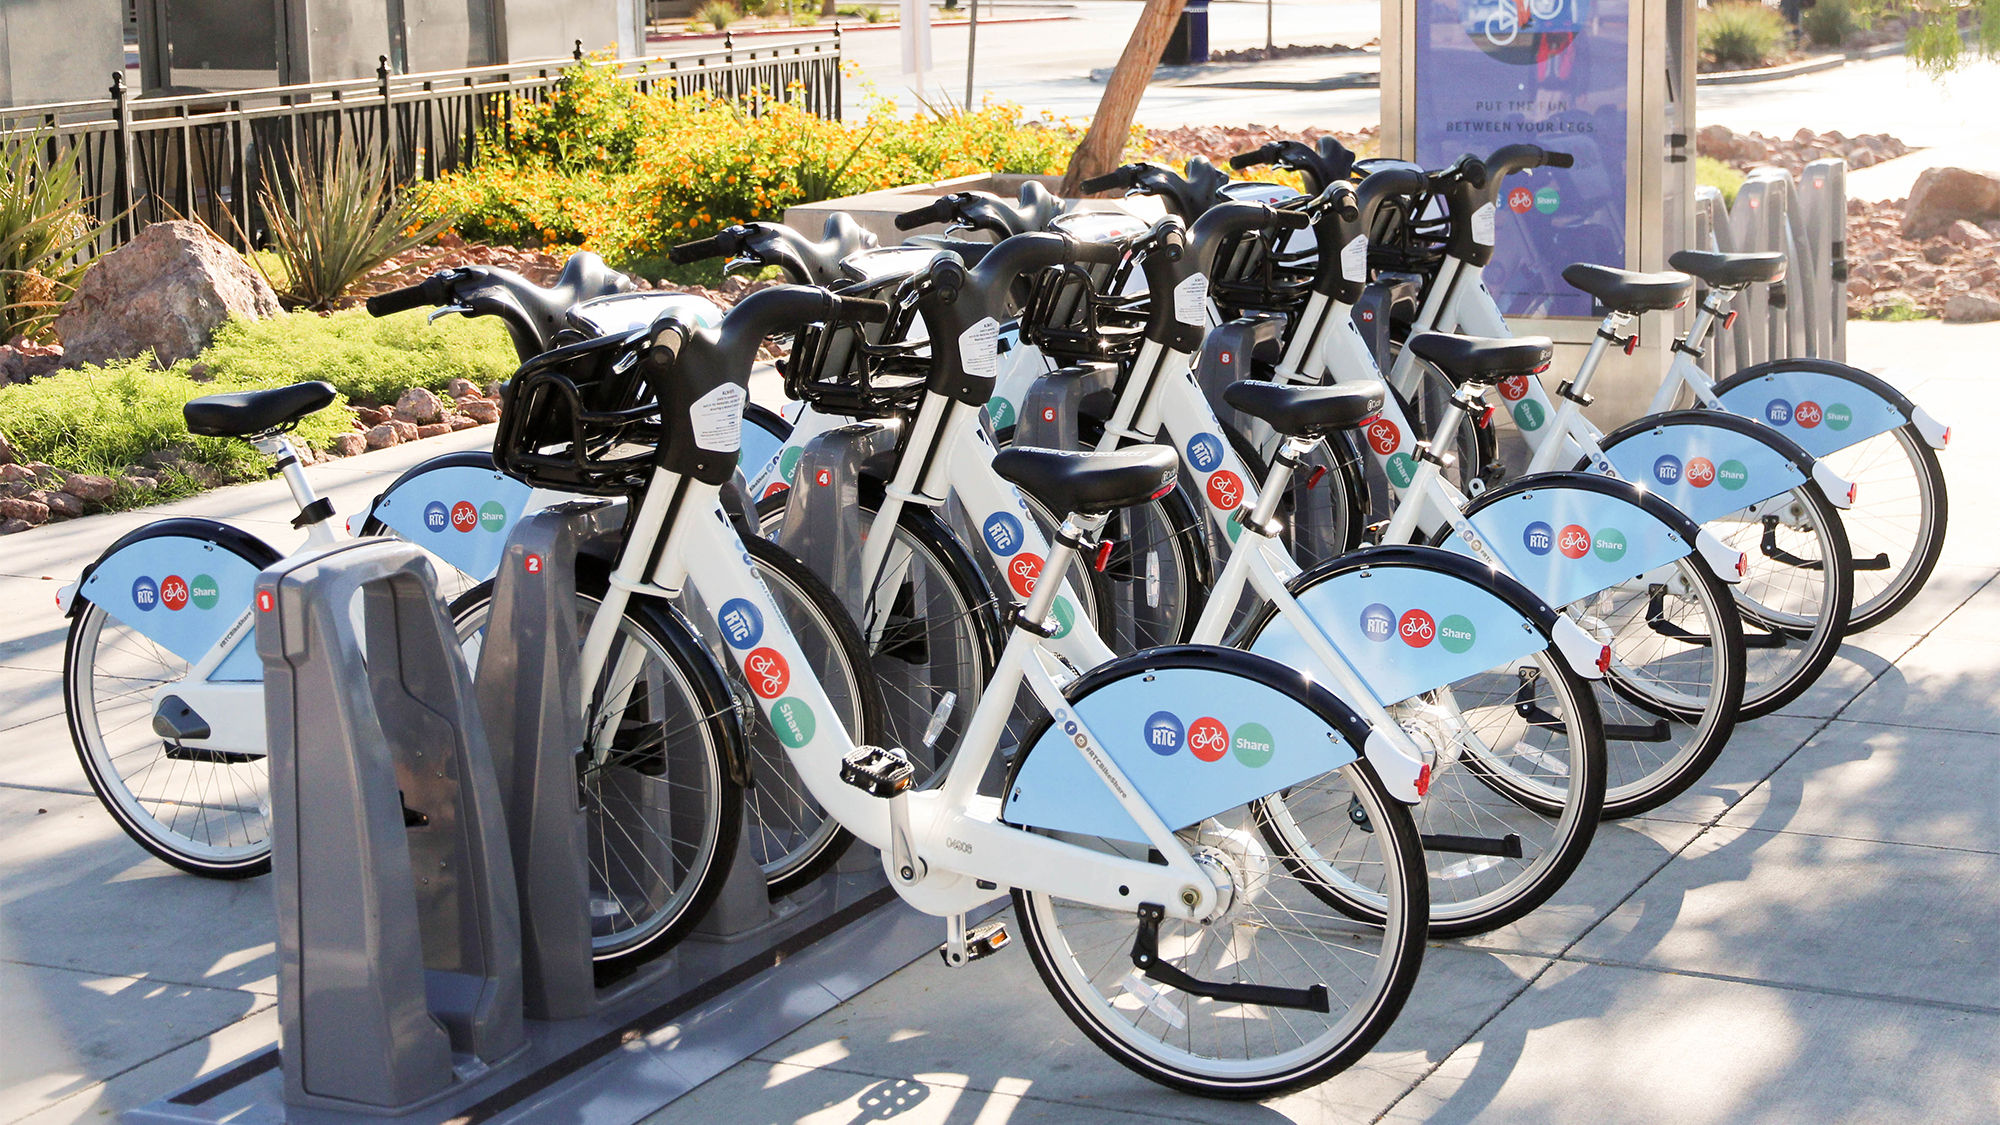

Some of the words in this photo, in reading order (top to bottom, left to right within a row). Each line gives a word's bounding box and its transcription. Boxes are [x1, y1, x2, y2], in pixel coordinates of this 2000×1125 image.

[1476, 101, 1502, 111] PUT
[1508, 101, 1533, 112] THE
[1539, 101, 1567, 112] FUN
[1446, 121, 1511, 132] BETWEEN
[1517, 121, 1554, 132] YOUR
[1536, 196, 1558, 205] Share
[1362, 312, 1374, 321] 10
[1221, 353, 1230, 363] 8
[1044, 410, 1054, 420] 6
[1520, 402, 1537, 428] Share
[1769, 409, 1787, 421] RTC
[1826, 412, 1850, 422] Share
[1191, 441, 1212, 467] RTC
[819, 473, 828, 485] 4
[1392, 457, 1411, 485] Share
[1659, 466, 1677, 479] RTC
[1720, 469, 1745, 481] Share
[428, 511, 445, 527] RTC
[481, 510, 504, 522] Share
[987, 520, 1013, 550] RTC
[1529, 534, 1549, 548] RTC
[1596, 539, 1623, 551] Share
[528, 556, 540, 572] 2
[137, 587, 154, 604] RTC
[193, 585, 217, 598] Share
[261, 595, 270, 610] 1
[724, 609, 749, 642] RTC
[1366, 618, 1388, 635] RTC
[1441, 627, 1472, 641] Share
[779, 703, 805, 743] Share
[1152, 728, 1176, 748] RTC
[1236, 737, 1270, 752] Share
[1085, 747, 1128, 799] #RTCBikeShare
